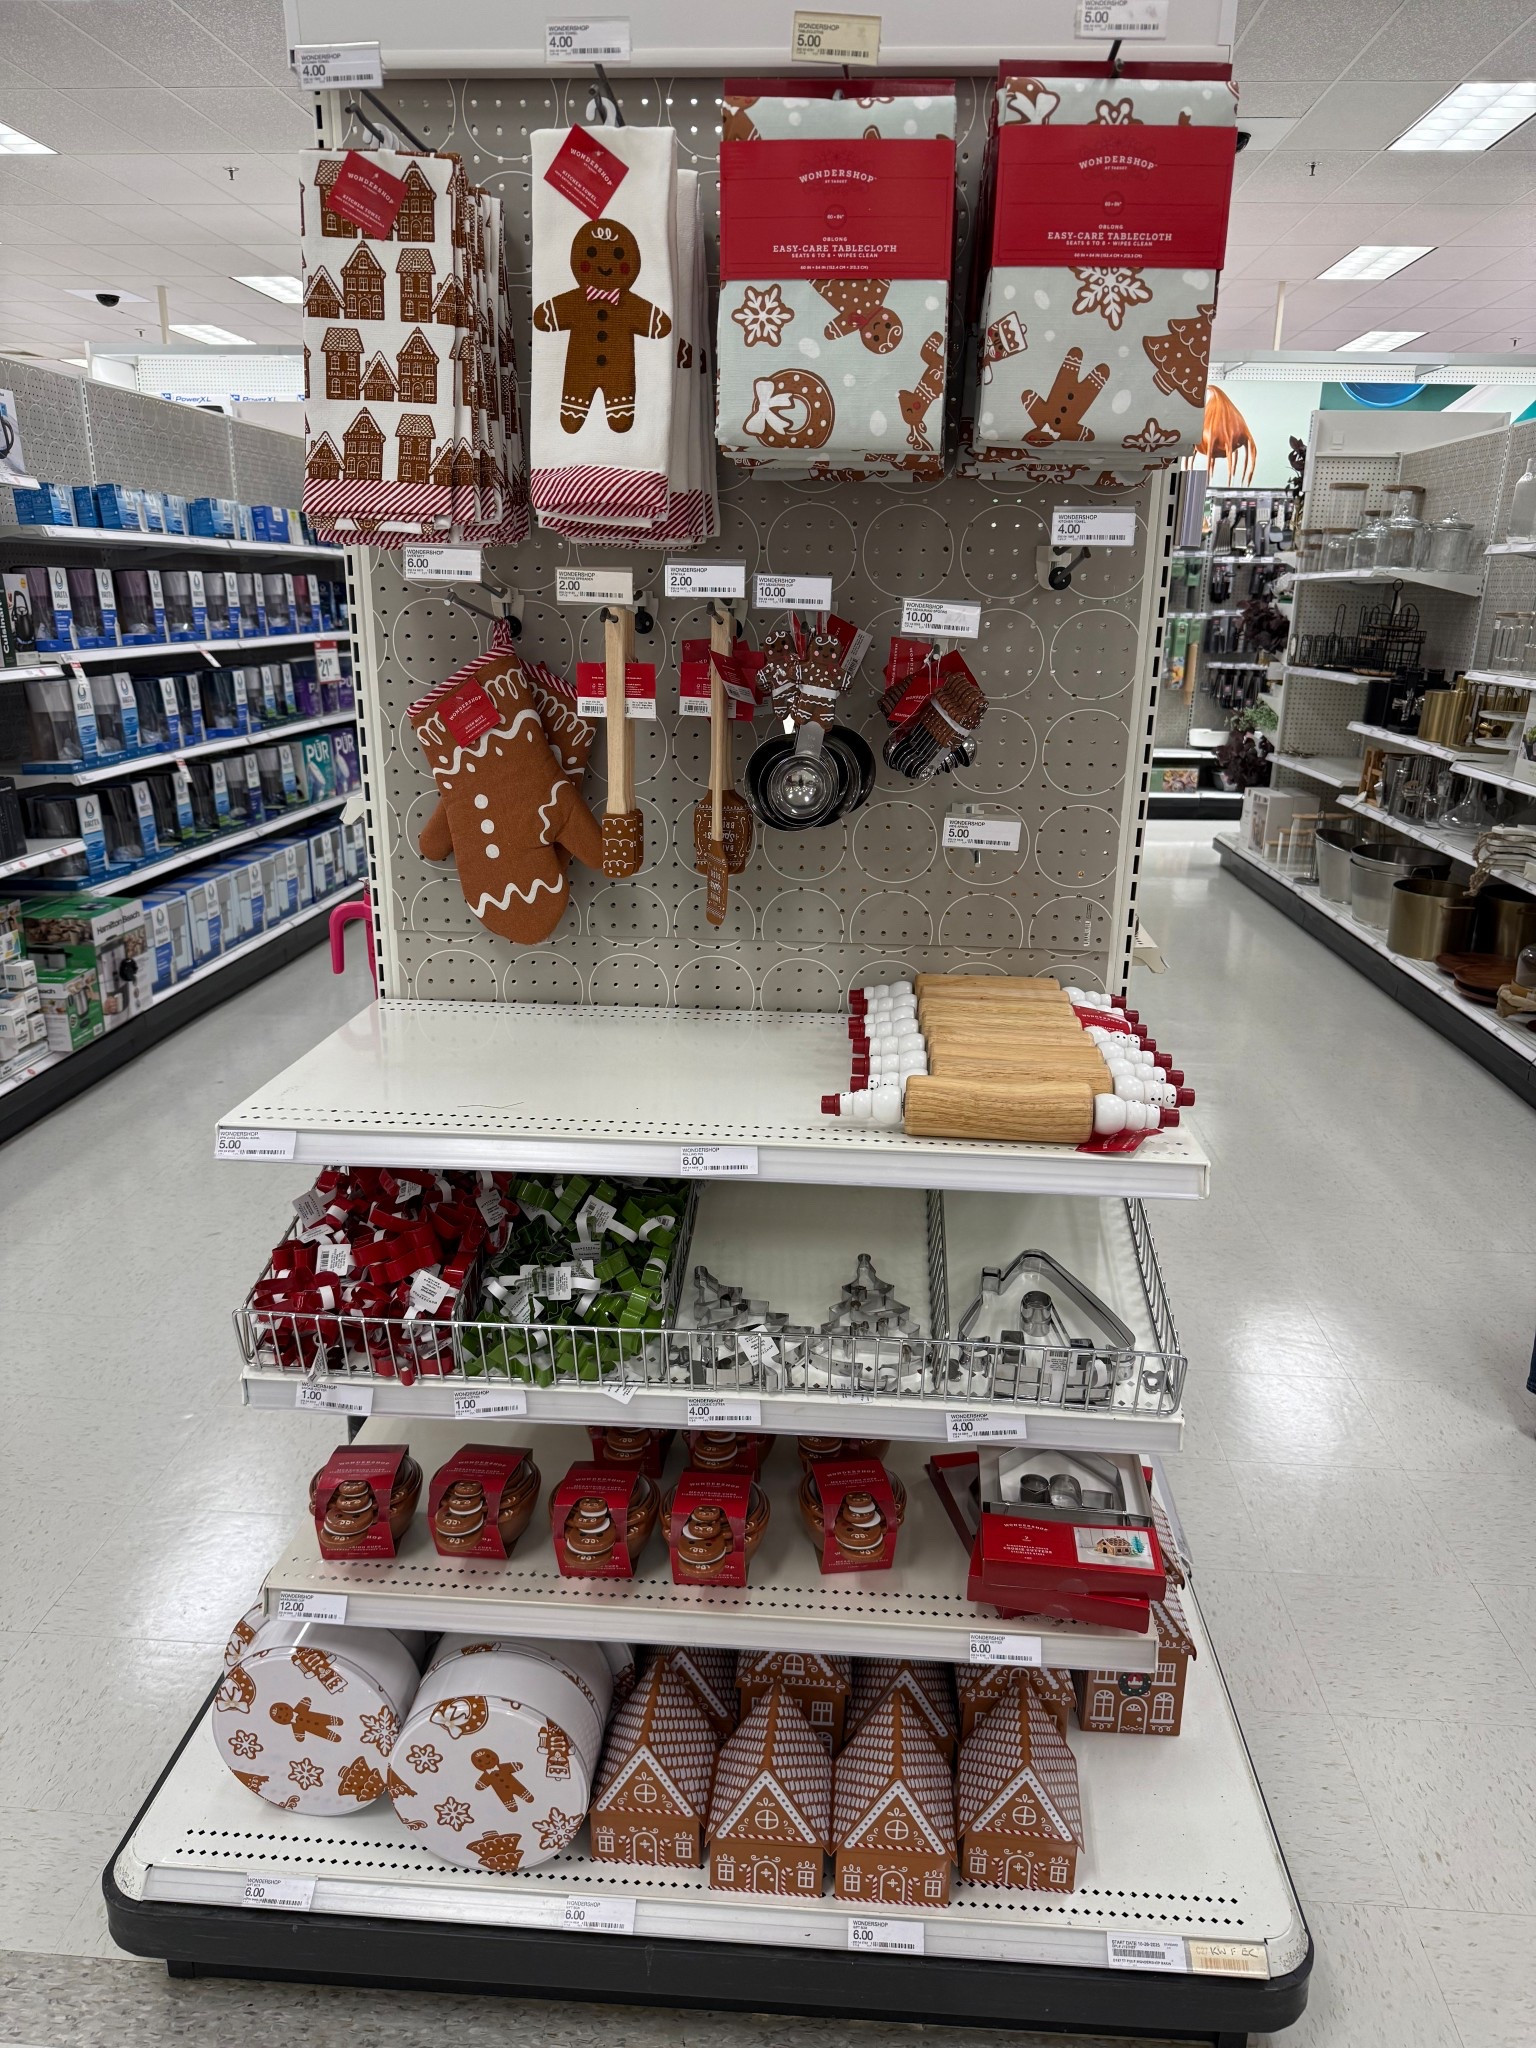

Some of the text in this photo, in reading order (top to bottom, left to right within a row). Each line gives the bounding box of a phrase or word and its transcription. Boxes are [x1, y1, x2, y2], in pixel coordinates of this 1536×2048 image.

[1085, 12, 1108, 23] 5.00
[798, 23, 839, 31] WONDERSHOP
[550, 36, 573, 47] 4.00
[797, 35, 821, 47] 5.00
[301, 53, 341, 62] WONDERSHOP
[303, 65, 326, 76] 4.00
[571, 148, 613, 187] WONDERSHOP
[1078, 155, 1155, 170] WONDERSHOP
[799, 169, 874, 183] WONDERSHOP
[347, 172, 394, 204] WONDERSHOP
[562, 170, 597, 202] KITCHEN TOWEL
[342, 194, 382, 221] KITCHEN TOWEL
[1047, 232, 1173, 241] EASY-CARE TABLECLOTH
[773, 245, 829, 253] EASY-CARE
[1058, 525, 1081, 534] 4.00
[408, 559, 429, 568] 6.00
[559, 581, 580, 591] 2.00
[671, 577, 693, 586] 2.00
[760, 587, 786, 597] 10.00
[906, 602, 944, 610] WONDERSHOP
[906, 612, 932, 622] 10.00
[449, 695, 483, 721] WONDERSHOP
[950, 819, 986, 827] WONDERSHOP
[949, 829, 970, 838] 5.00
[96, 911, 141, 935] Hamilton Beach
[219, 1140, 241, 1149] 5.00
[683, 1156, 704, 1166] 6.00
[302, 1391, 322, 1400] 1.00
[455, 1400, 476, 1409] 1.00
[689, 1407, 710, 1416] 4.00
[952, 1422, 973, 1431] 4.00
[1003, 1523, 1049, 1531] WONDERSHOP
[280, 1602, 304, 1611] 12.00
[971, 1644, 991, 1653] 6.00
[245, 1887, 265, 1897] 6.00
[565, 1909, 585, 1920] 6.00
[853, 1930, 873, 1940] 6.00
